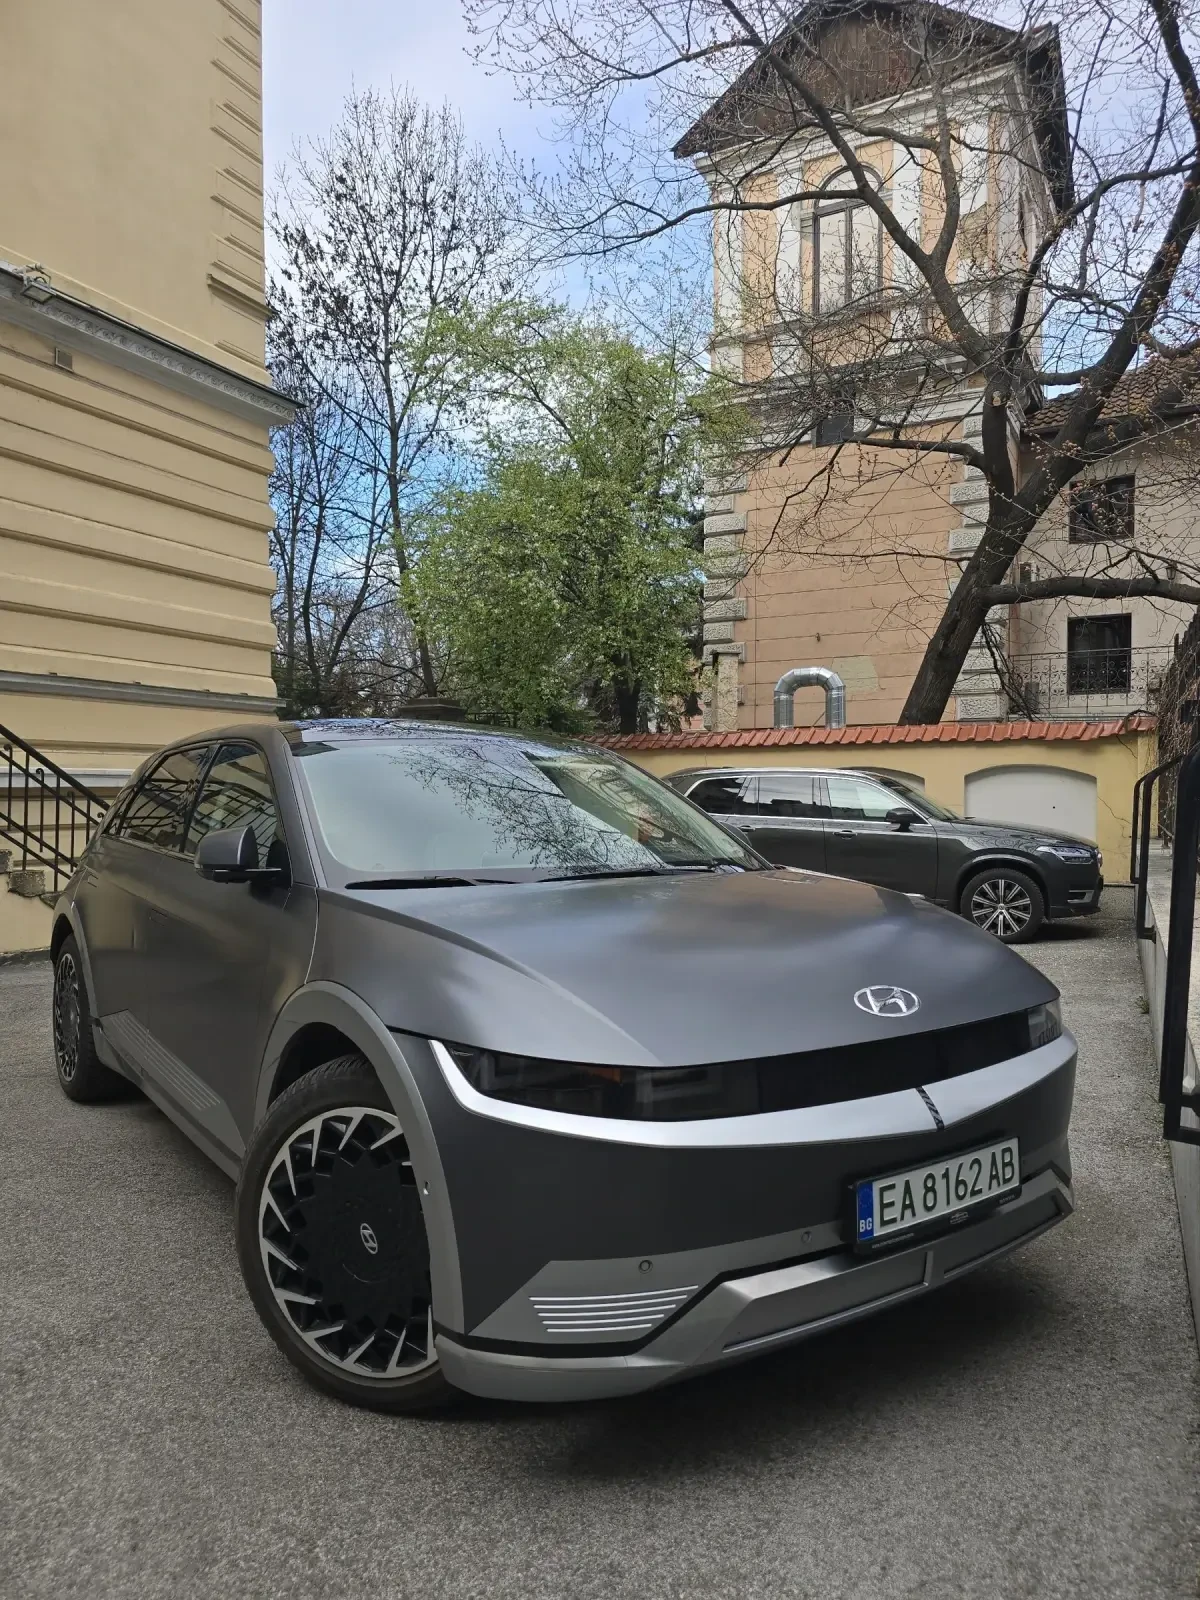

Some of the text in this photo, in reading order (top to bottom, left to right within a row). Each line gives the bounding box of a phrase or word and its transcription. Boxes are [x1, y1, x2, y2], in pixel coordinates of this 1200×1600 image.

[879, 1146, 1015, 1228] EA 8162 AB
[859, 1217, 873, 1233] BG
